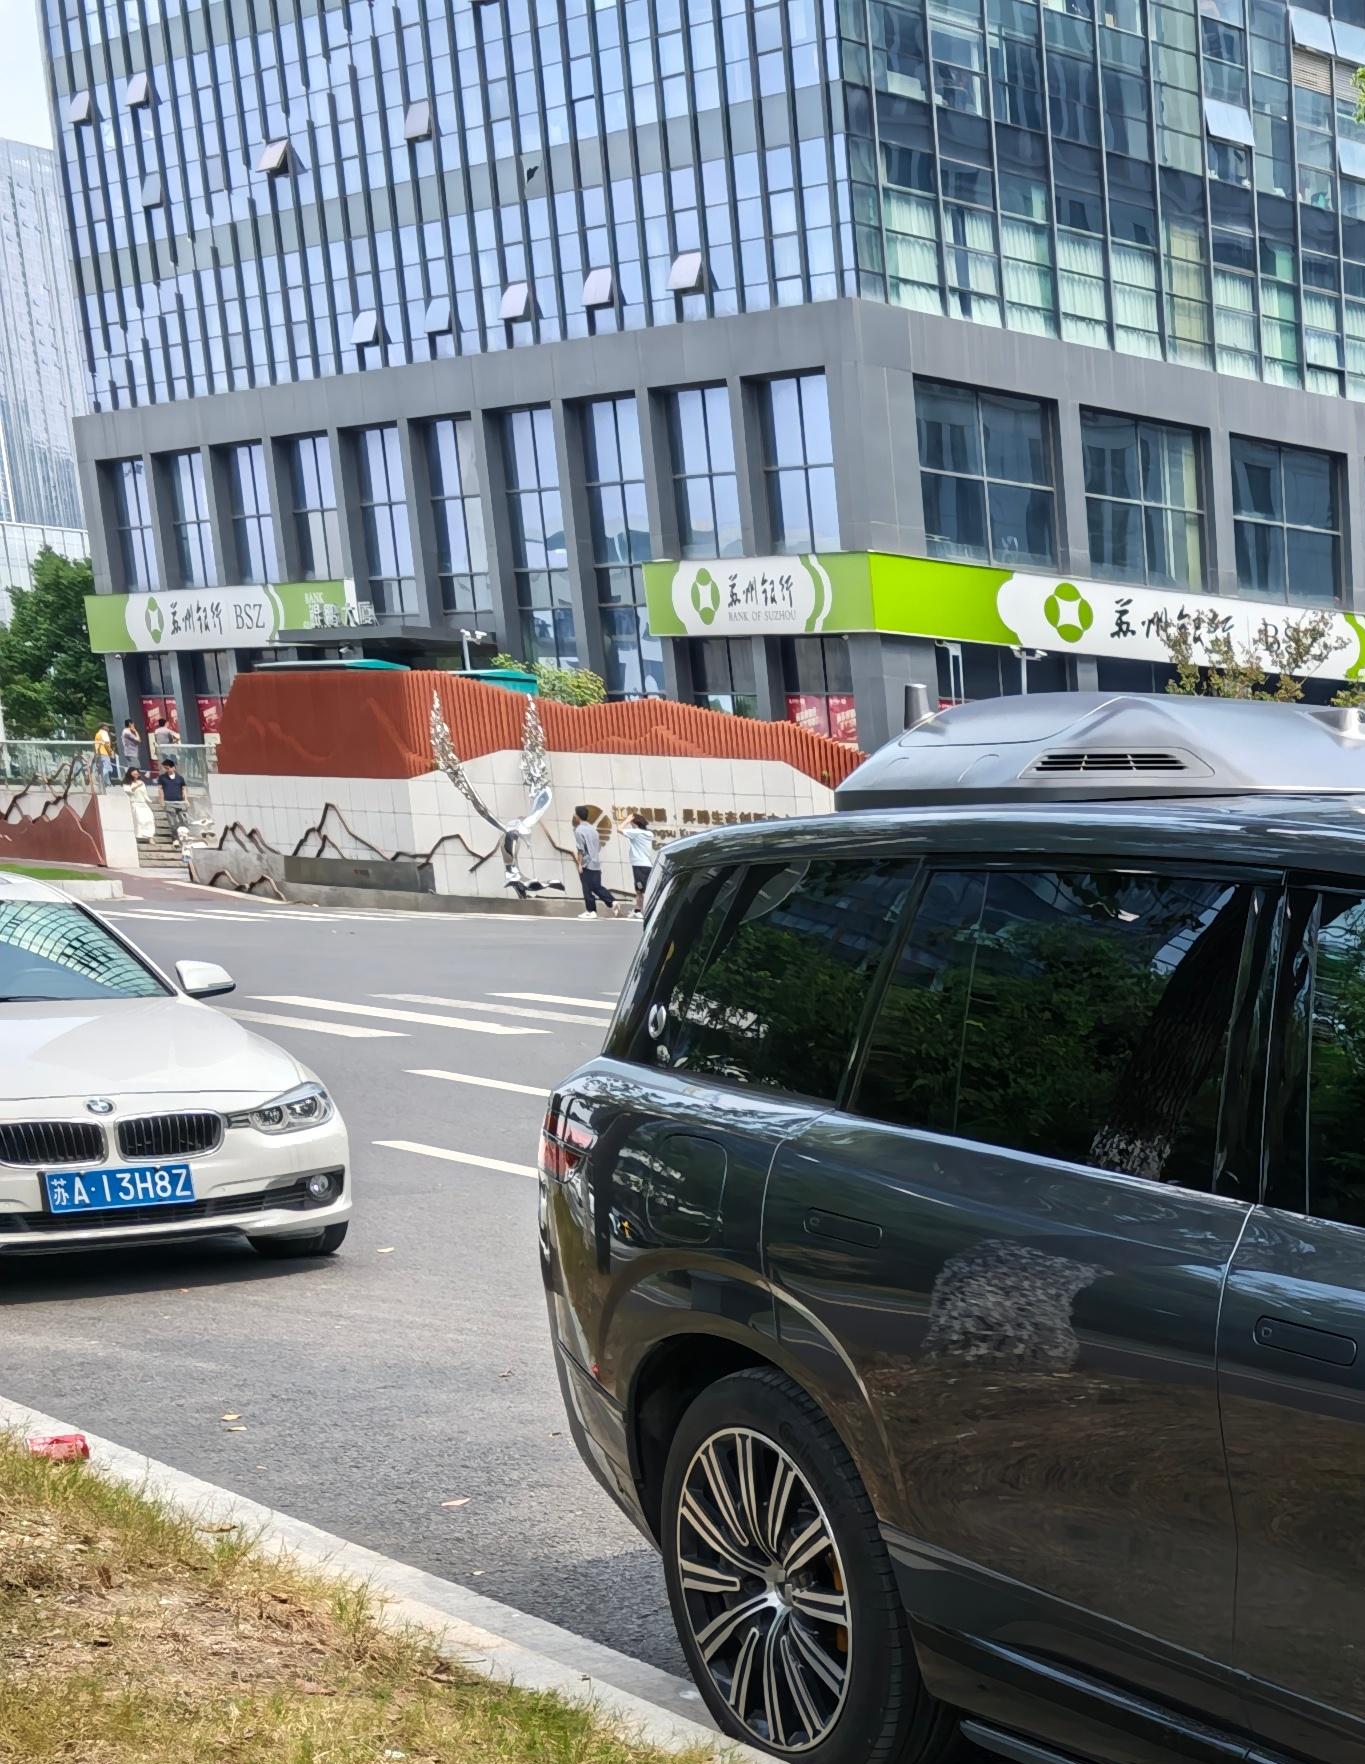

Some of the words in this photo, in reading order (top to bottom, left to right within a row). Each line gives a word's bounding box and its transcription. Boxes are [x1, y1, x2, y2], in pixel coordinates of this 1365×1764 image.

[727, 572, 795, 608] 苏州银行
[170, 600, 223, 635] 苏州银行
[234, 603, 266, 629] BSZ
[728, 611, 749, 622] BANK
[752, 611, 762, 621] OF
[764, 610, 797, 621] SUZHOU
